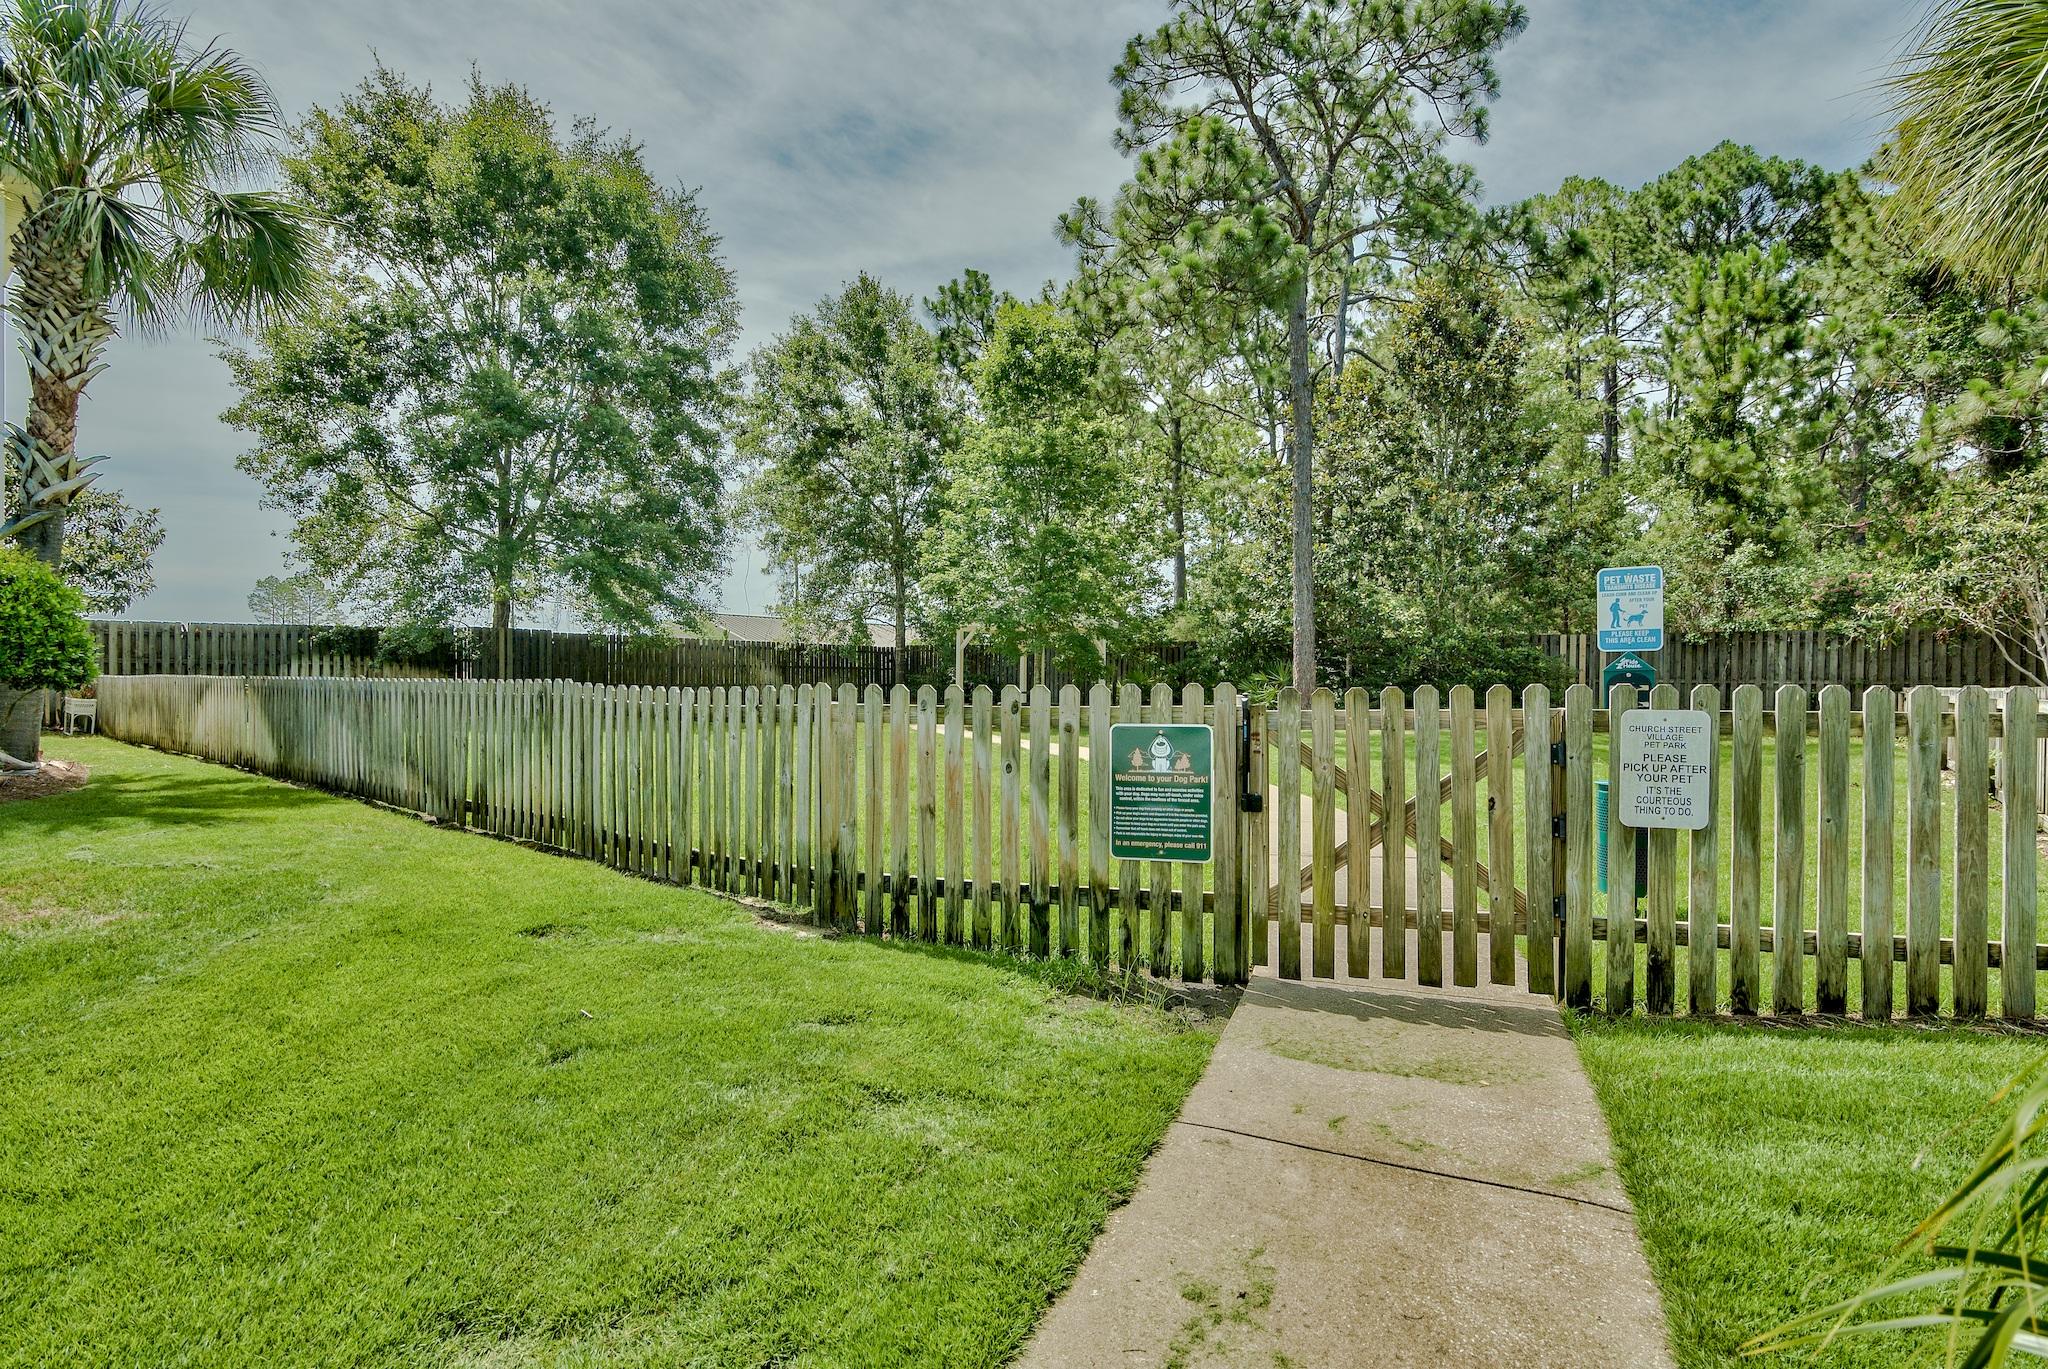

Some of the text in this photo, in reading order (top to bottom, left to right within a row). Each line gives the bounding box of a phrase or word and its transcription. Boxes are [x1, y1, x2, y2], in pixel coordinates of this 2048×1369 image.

[1604, 574, 1656, 584] PET WASTE
[1643, 754, 1686, 763] PLEASE
[1623, 763, 1706, 774] PICK UP AFTER
[1115, 774, 1208, 784] Welcome to your Dog Park!
[1637, 774, 1693, 784] YOUR PET
[1664, 787, 1682, 795] THE
[1636, 796, 1692, 806] COURTEOUS
[1634, 806, 1694, 816] THING TO DO.
